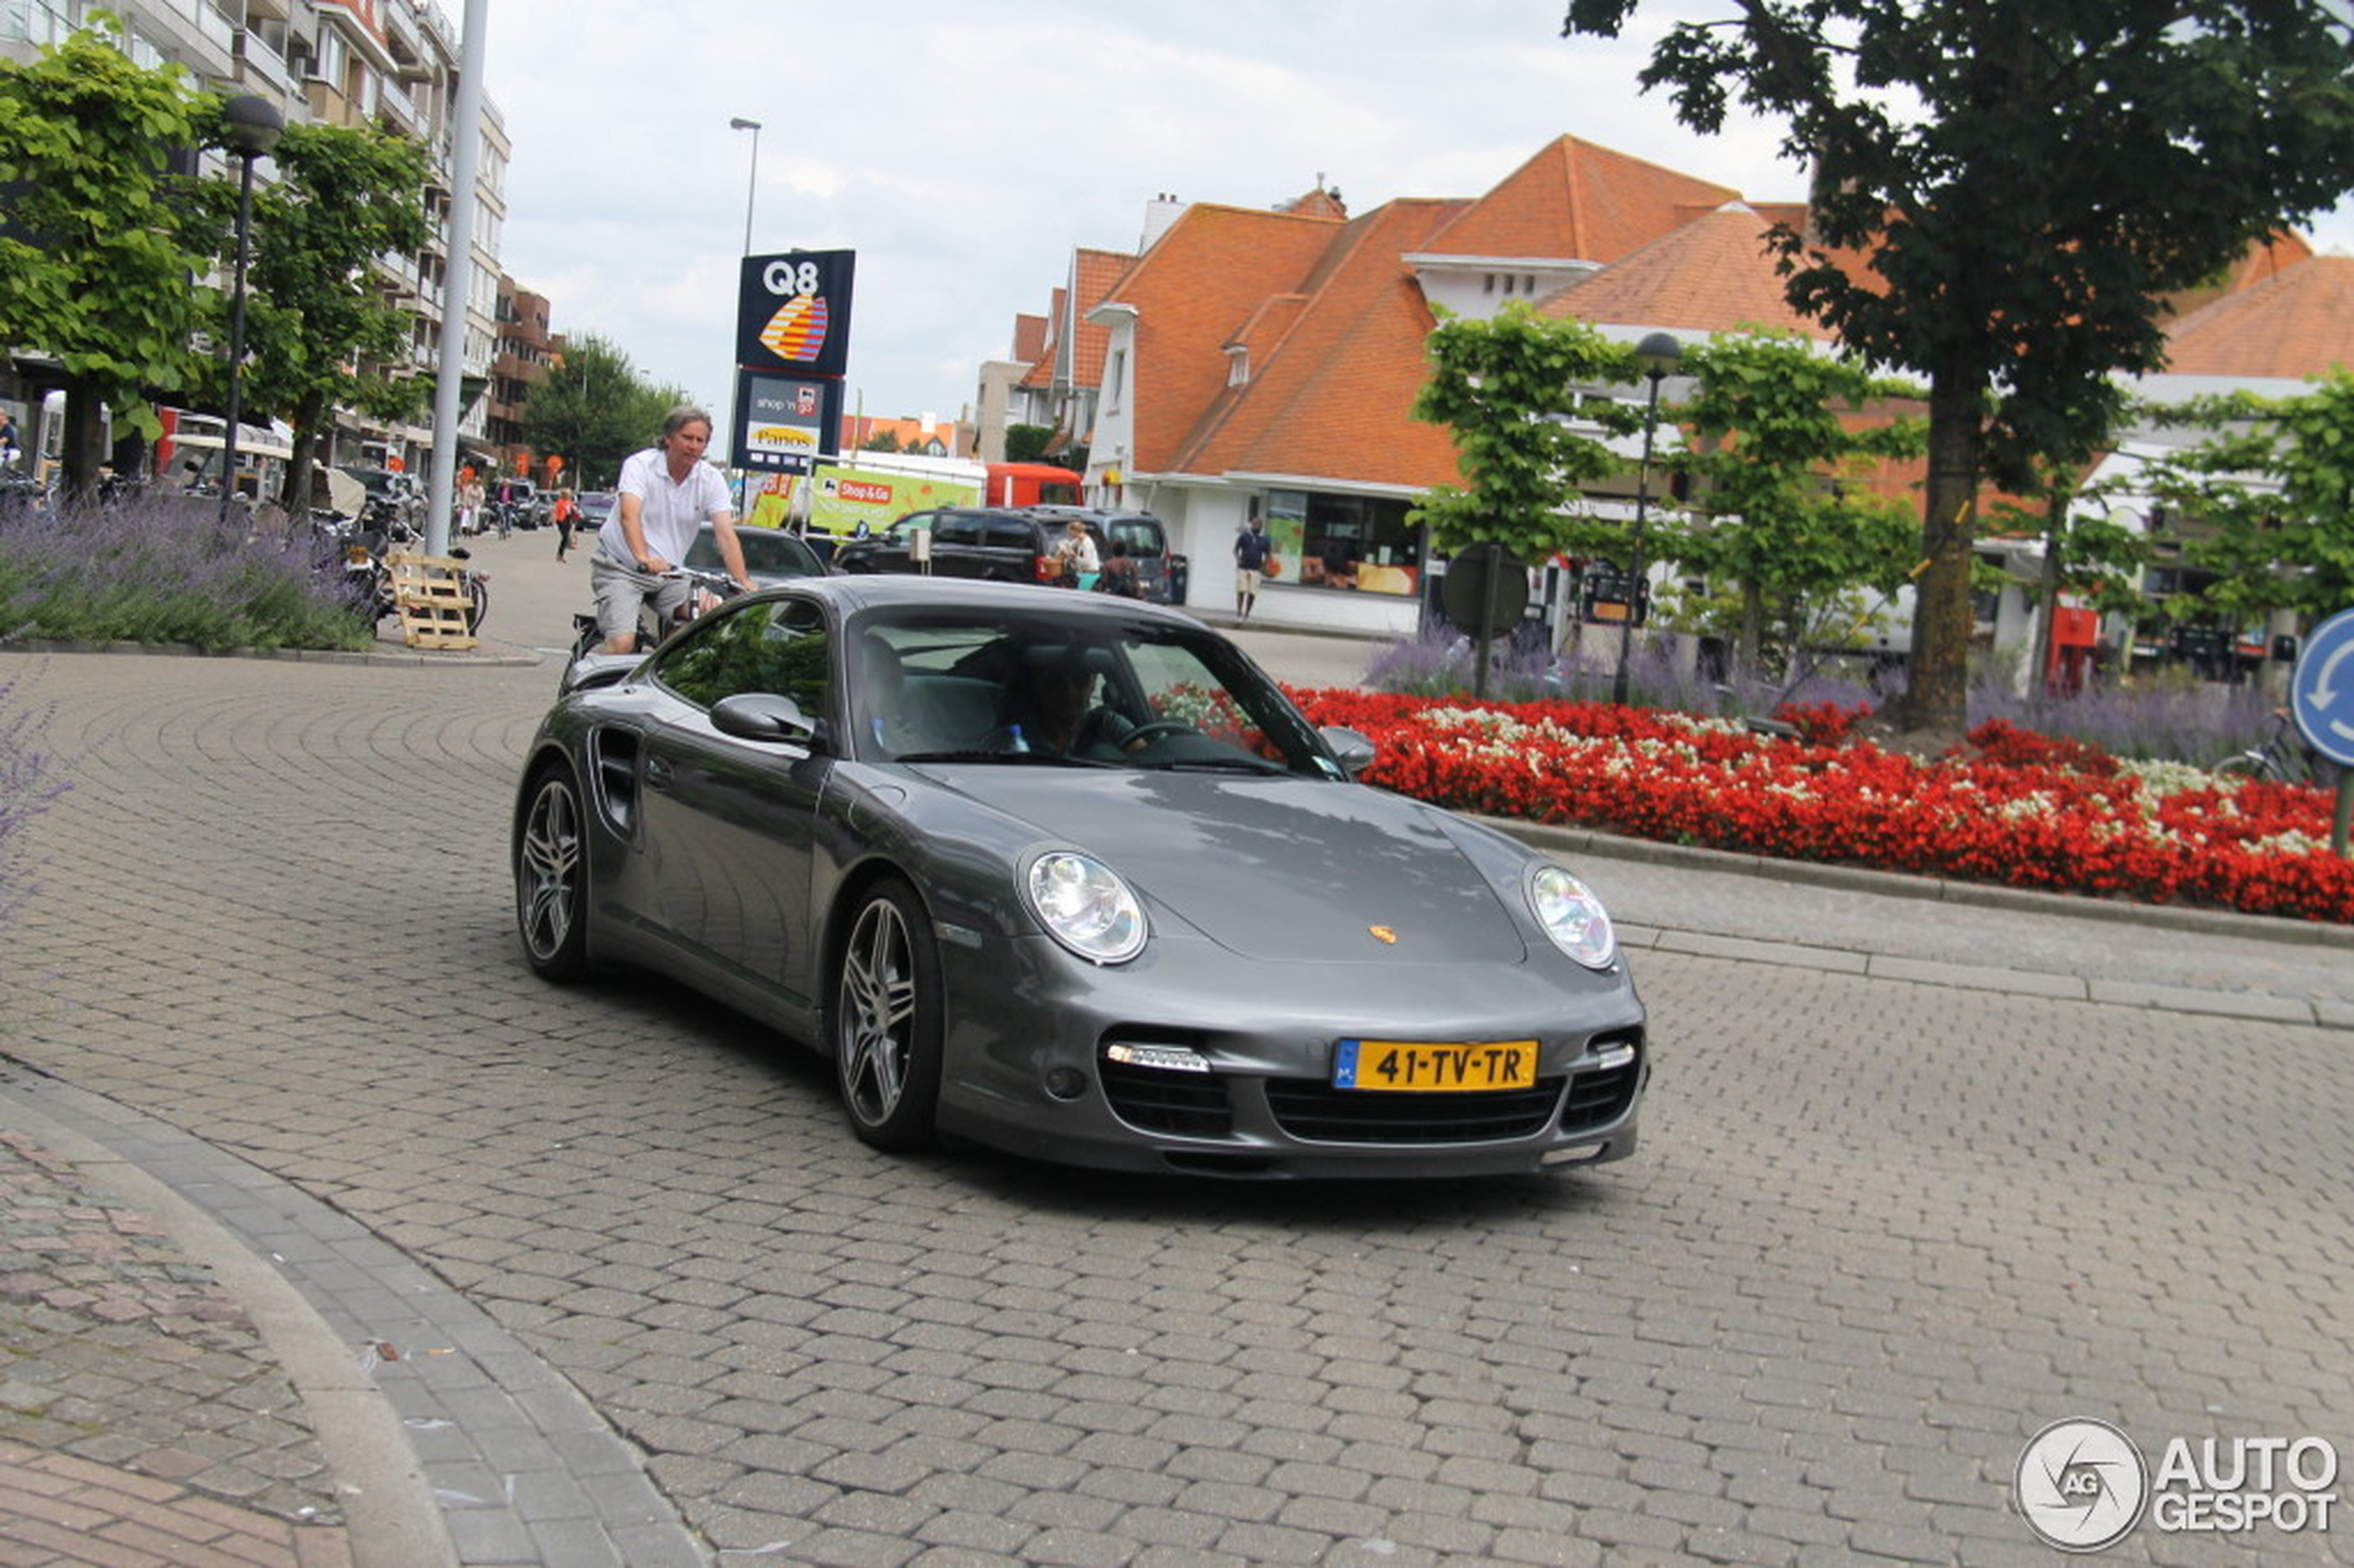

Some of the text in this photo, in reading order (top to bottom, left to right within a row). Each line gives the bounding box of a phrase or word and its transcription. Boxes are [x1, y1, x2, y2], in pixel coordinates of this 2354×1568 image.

[763, 260, 818, 296] Q8
[757, 398, 785, 412] shop
[757, 429, 811, 449] Panos
[1376, 1049, 1521, 1083] 41-TV-TR
